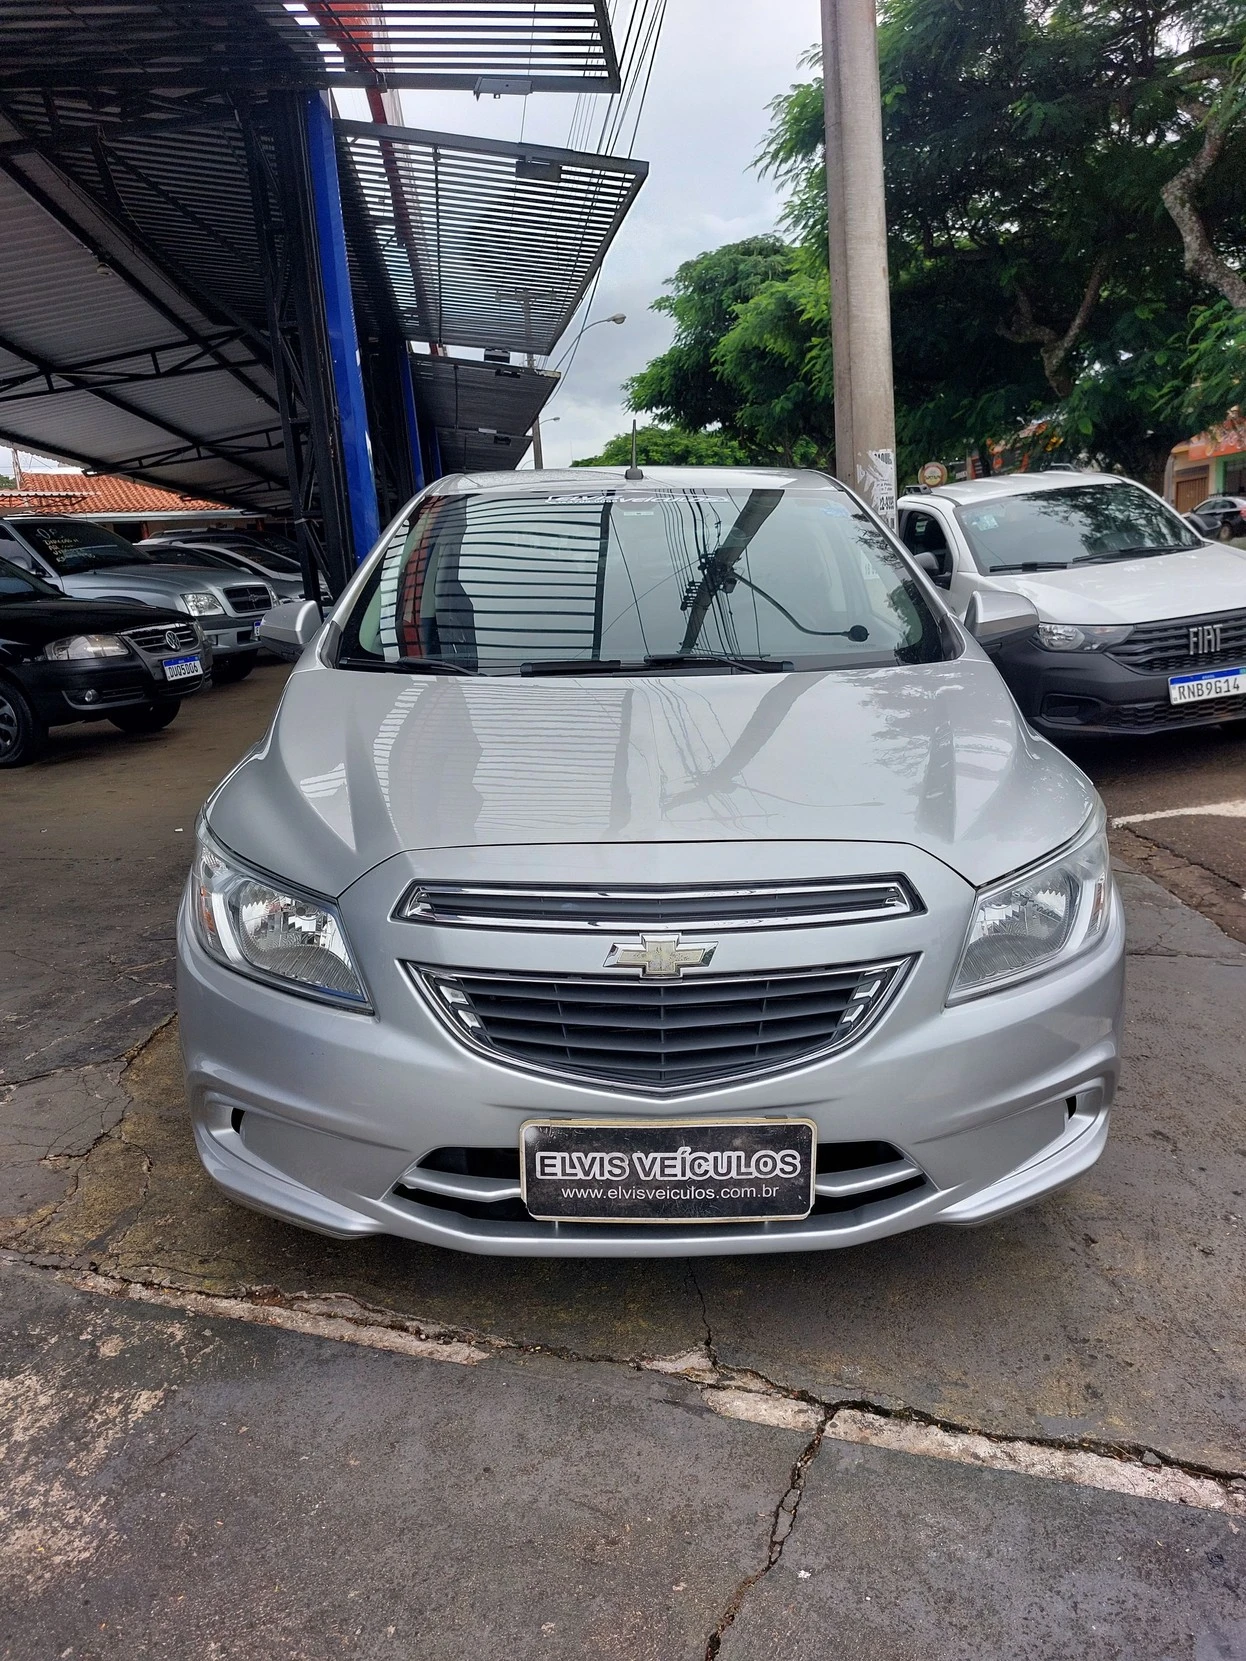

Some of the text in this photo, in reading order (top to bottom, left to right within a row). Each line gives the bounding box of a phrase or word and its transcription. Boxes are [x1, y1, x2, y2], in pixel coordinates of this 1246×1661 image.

[1189, 624, 1223, 655] FIAT
[1178, 678, 1240, 700] RNB9G14
[536, 1147, 800, 1180] ELVIS VEÍCULOS
[561, 1184, 779, 1199] www.elvisveiculos.com.br
